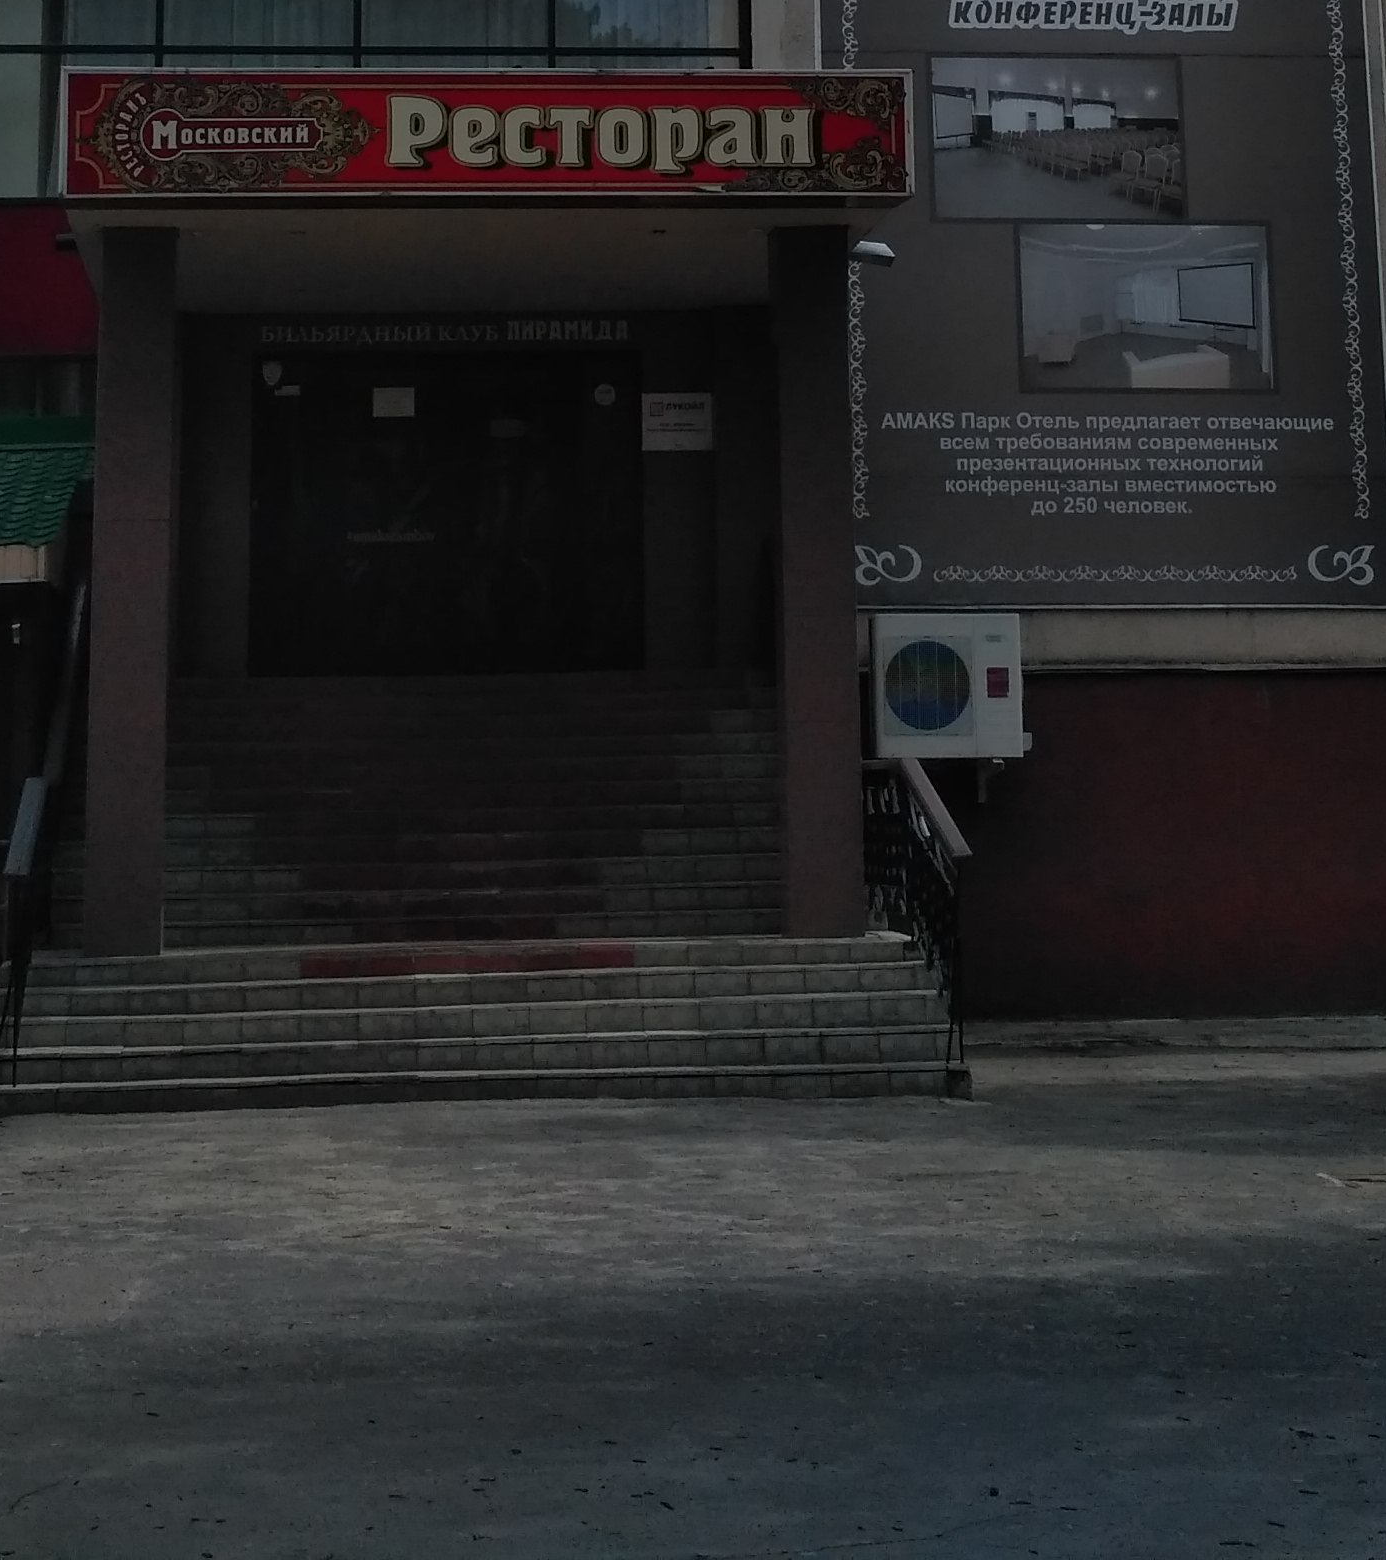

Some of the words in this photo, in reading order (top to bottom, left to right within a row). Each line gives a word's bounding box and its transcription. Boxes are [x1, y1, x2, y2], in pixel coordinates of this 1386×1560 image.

[386, 94, 816, 175] Ресторан
[260, 322, 432, 346] БИЛЬЯРДНЫЙ
[438, 325, 499, 343] КЛУБ
[507, 319, 629, 341] ПИРАМИДА
[881, 412, 955, 429] AMAKS
[961, 412, 1011, 433] Парк
[1016, 412, 1080, 429] Отель
[1085, 416, 1202, 433] предлагает
[1206, 416, 1334, 433] отвечающие
[940, 437, 990, 451] всем
[995, 433, 1132, 453] требованиям
[1137, 437, 1279, 453] современных
[956, 457, 1142, 474] презентационных
[1146, 454, 1263, 472] технологий
[945, 475, 1118, 496] конференц-залы
[1125, 479, 1277, 493] вместимостью
[1030, 500, 1058, 516] до
[1063, 497, 1098, 514] 250
[1103, 500, 1193, 514] человек.
